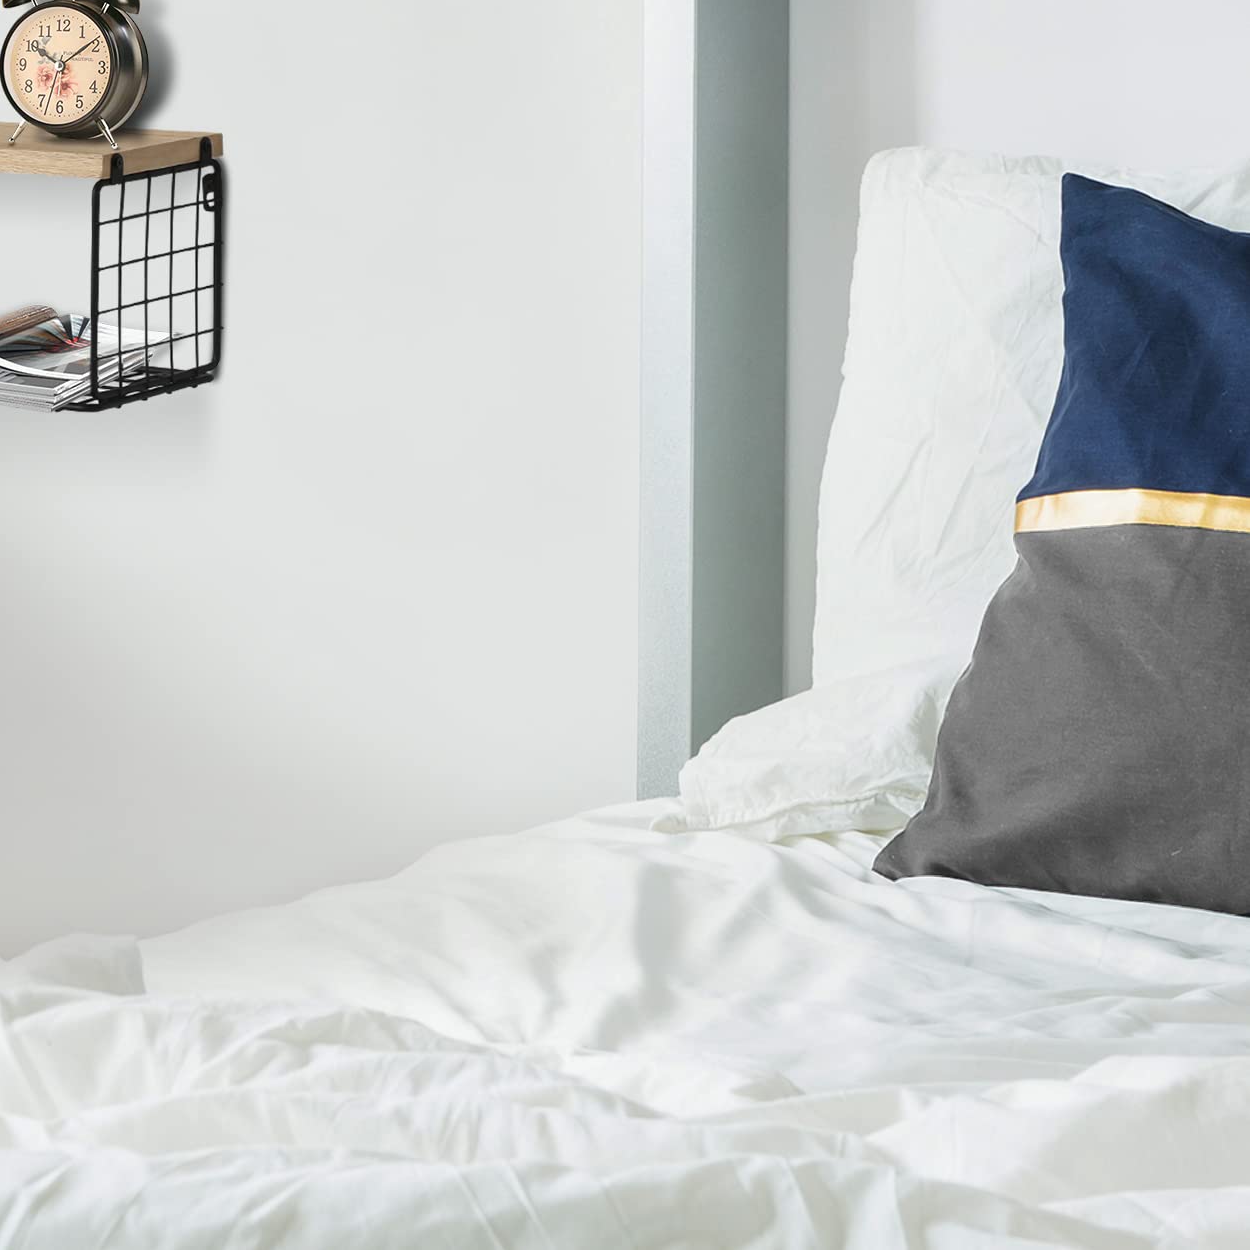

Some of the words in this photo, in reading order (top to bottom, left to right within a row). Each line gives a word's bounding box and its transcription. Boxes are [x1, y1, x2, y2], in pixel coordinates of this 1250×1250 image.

[38, 26, 52, 37] 11
[56, 19, 71, 32] 12
[79, 26, 86, 38] 1
[26, 40, 39, 52] 10
[92, 40, 100, 52] 2
[19, 58, 26, 71] 9
[98, 60, 106, 74] 3
[25, 80, 33, 93] 8
[89, 80, 98, 94] 4
[38, 94, 46, 107] 7
[56, 100, 64, 114] 6
[76, 96, 84, 108] 5
